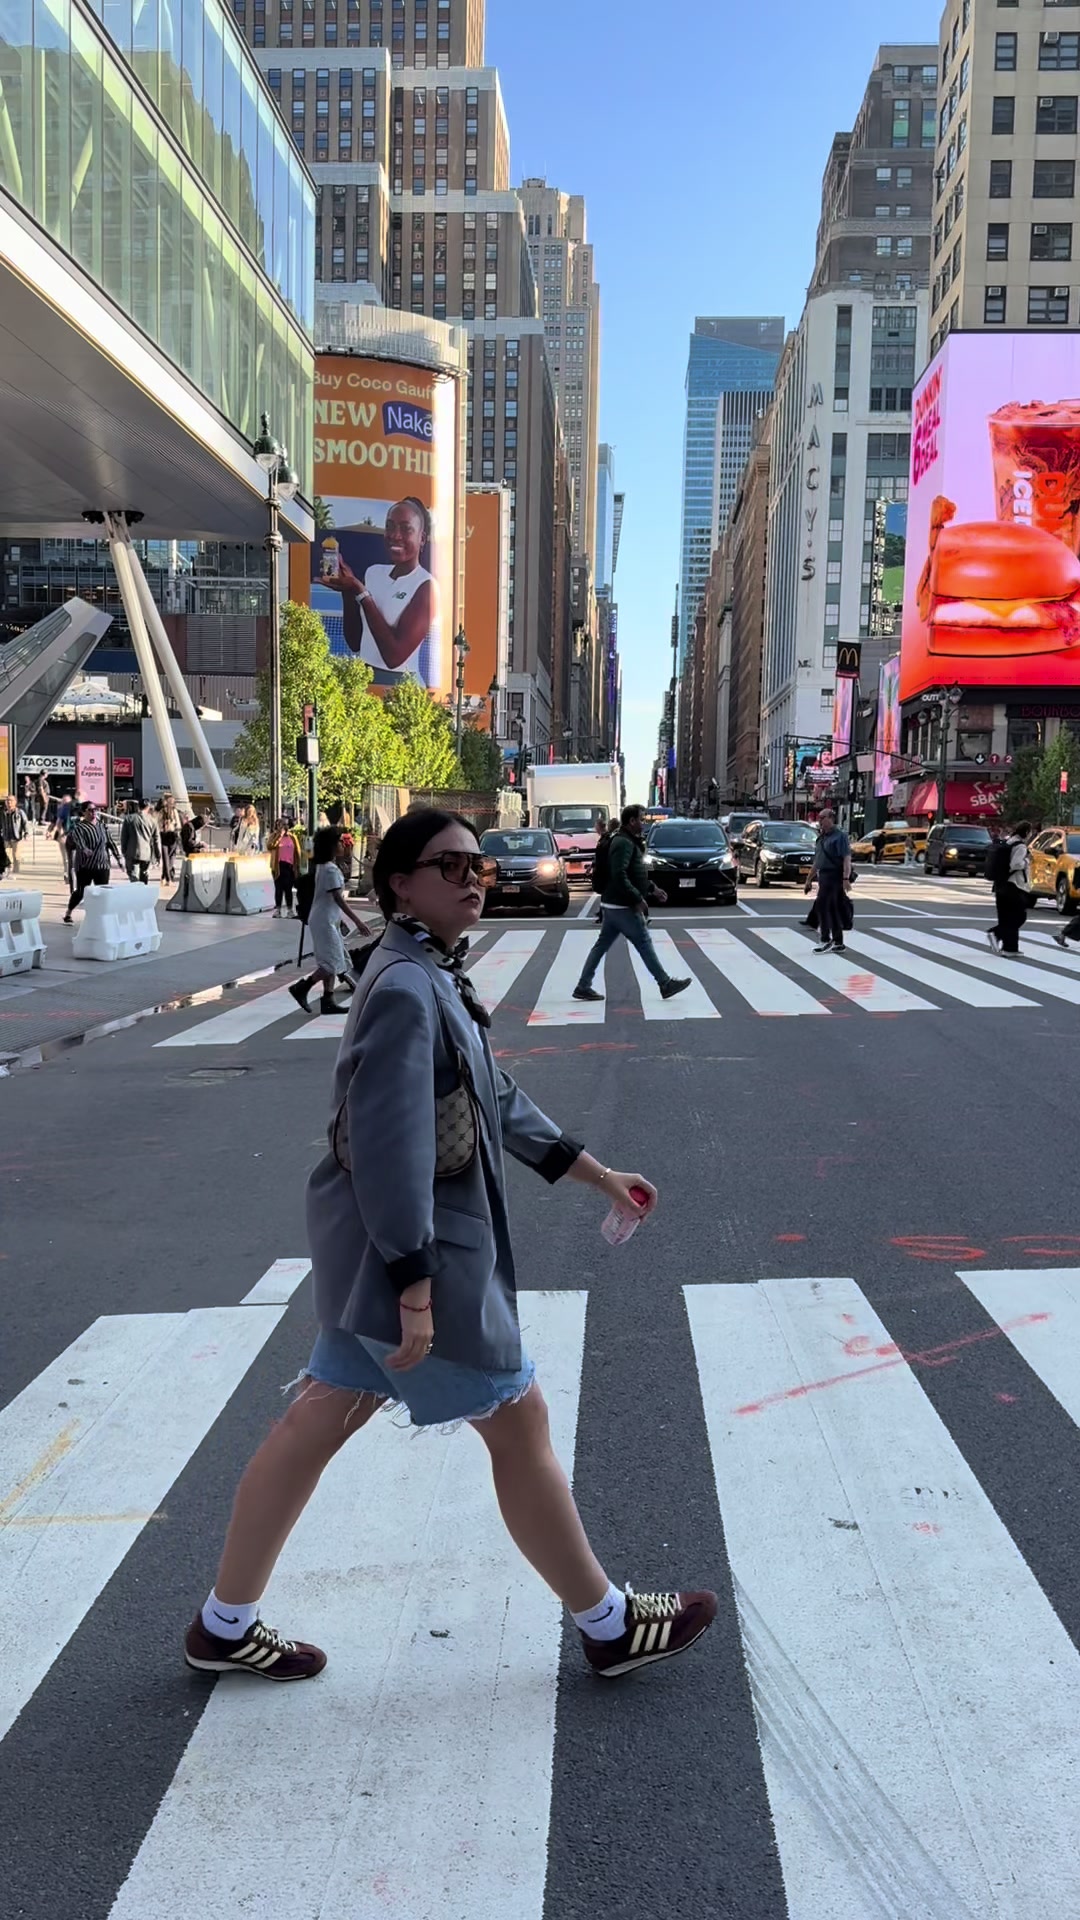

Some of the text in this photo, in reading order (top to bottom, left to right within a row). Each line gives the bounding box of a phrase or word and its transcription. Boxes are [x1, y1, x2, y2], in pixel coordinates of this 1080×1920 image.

[314, 370, 343, 390] Buy
[347, 372, 392, 392] Coco
[314, 400, 433, 438] NEW Nake
[22, 757, 59, 767] TACOS
